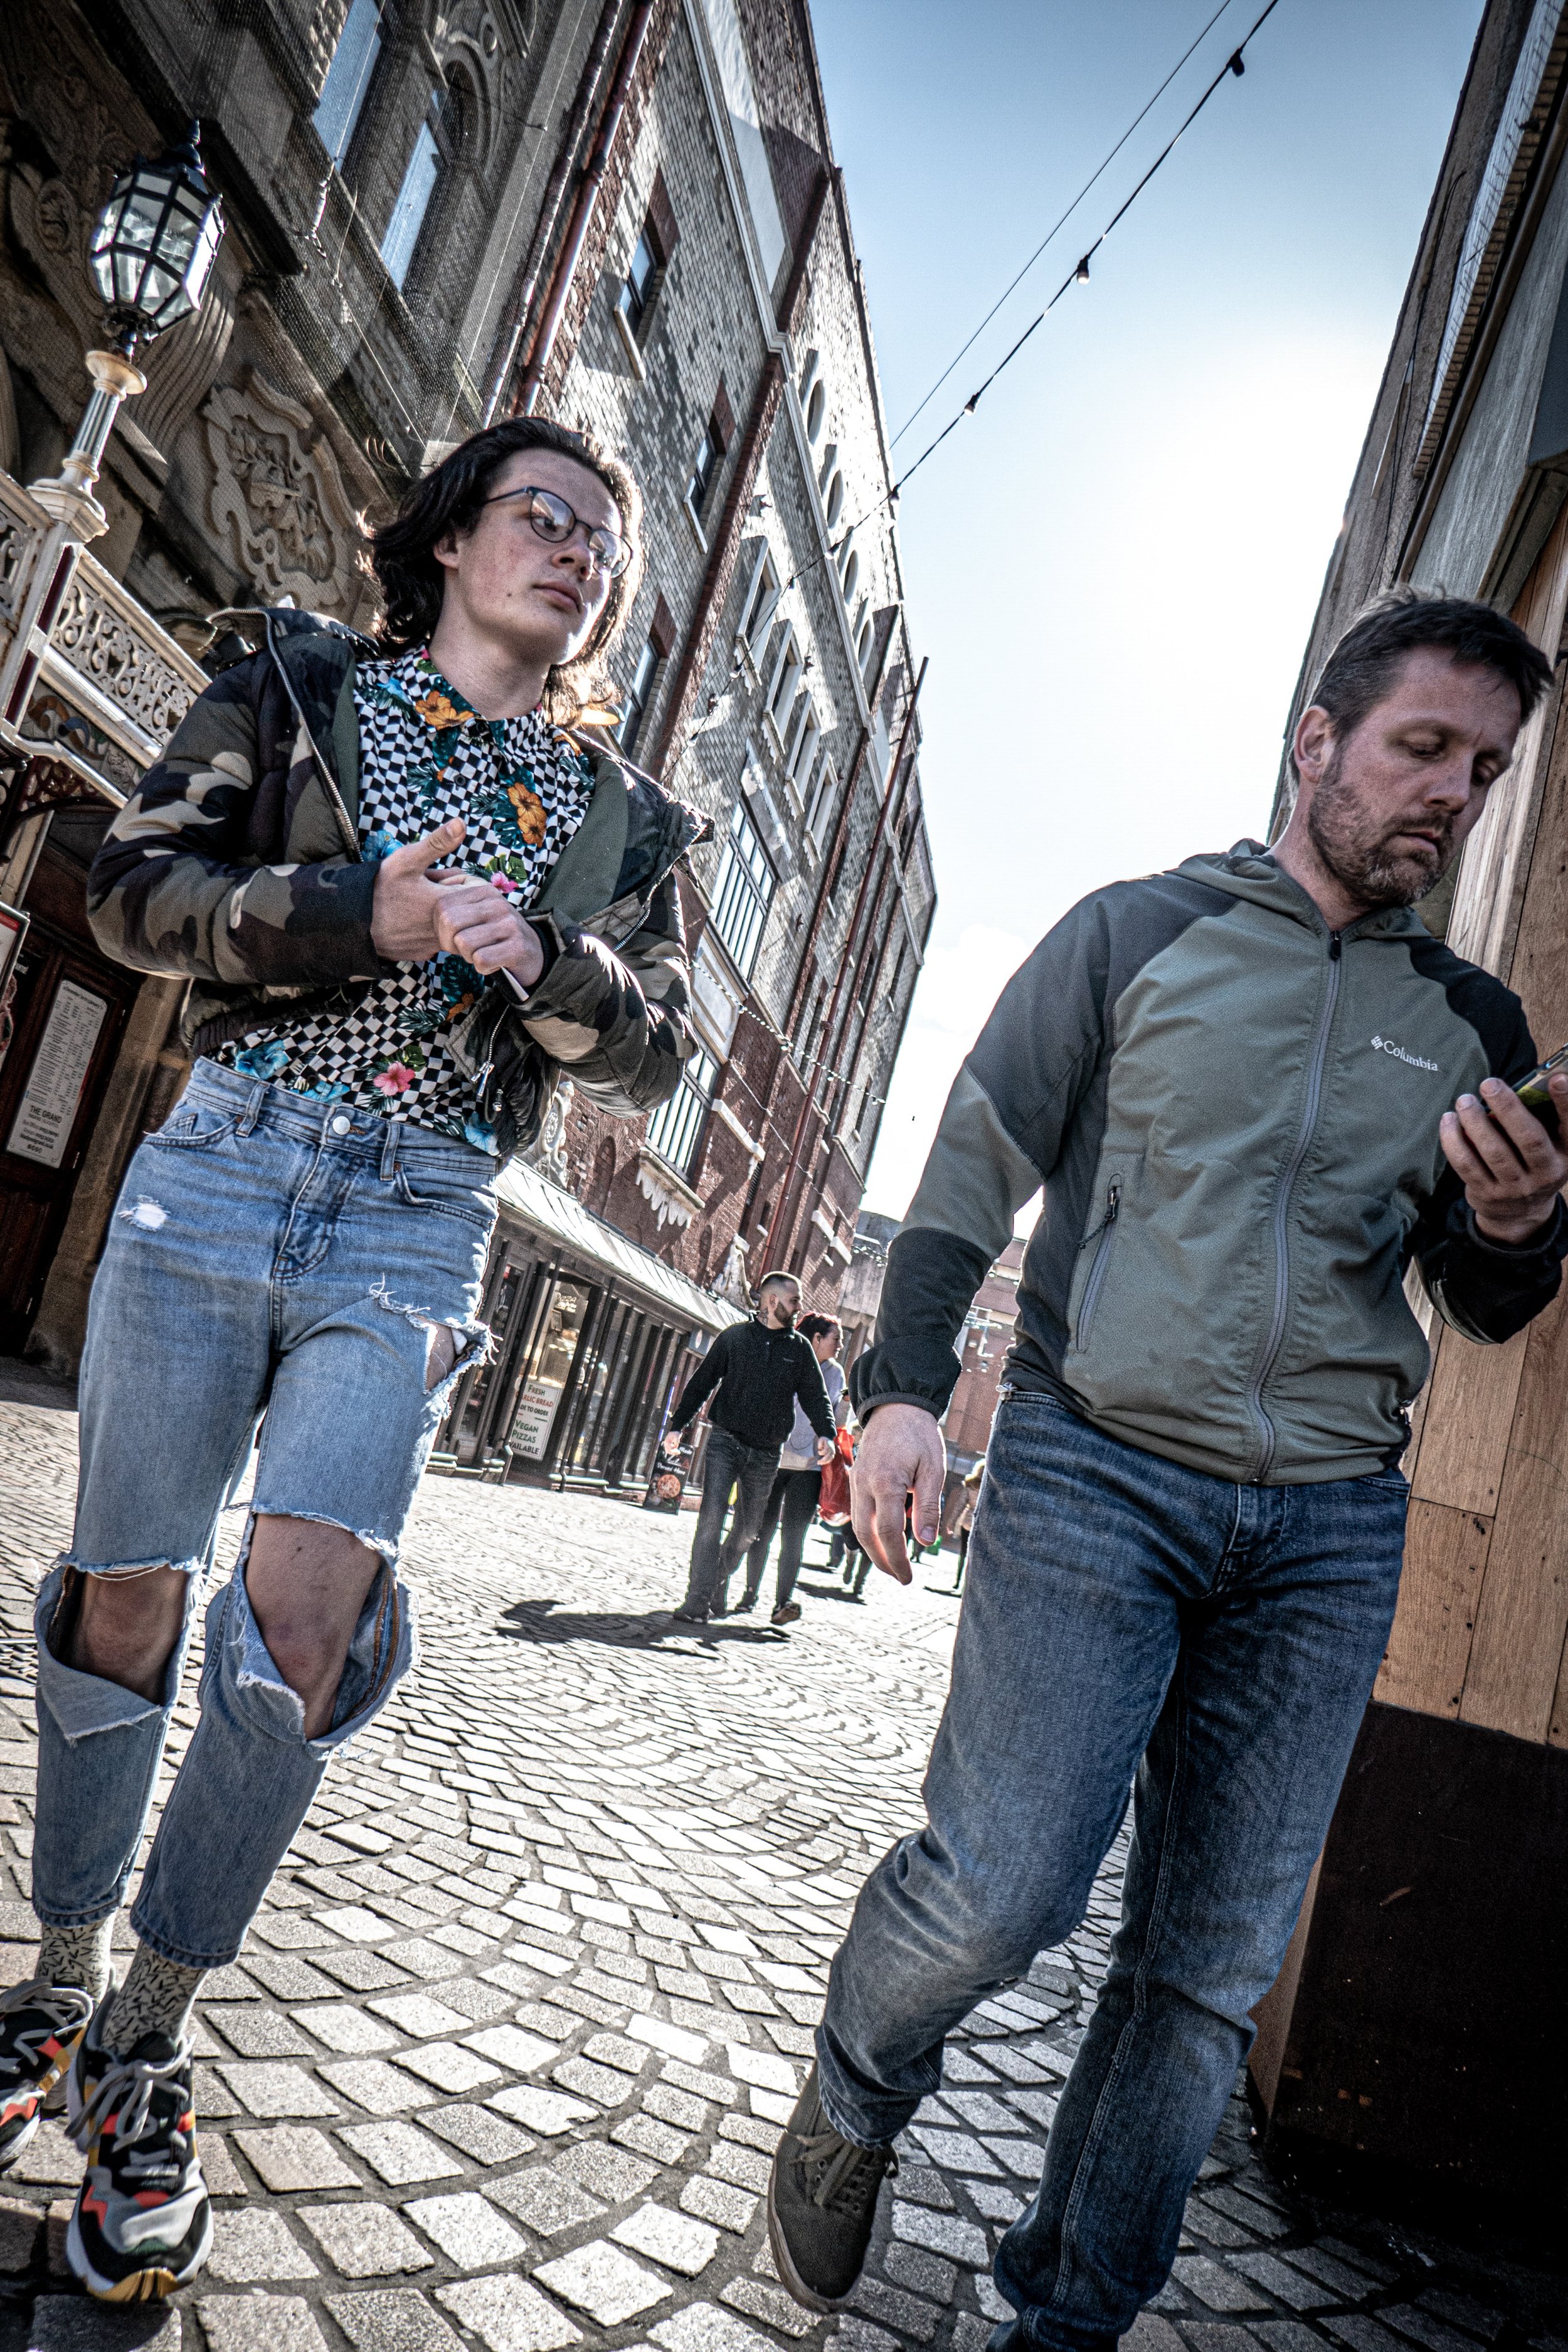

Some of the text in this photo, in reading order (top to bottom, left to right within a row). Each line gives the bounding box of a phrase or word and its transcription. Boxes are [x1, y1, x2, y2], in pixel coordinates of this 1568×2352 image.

[1384, 1041, 1439, 1071] Columbia
[30, 1105, 42, 1116] THE
[42, 1110, 62, 1123] GRAND
[528, 1384, 546, 1396] FRESH
[536, 1397, 553, 1407] BREAD
[516, 1419, 539, 1433] VEGAN
[512, 1429, 536, 1443] PIZZAS
[510, 1441, 539, 1455] VAILABLE
